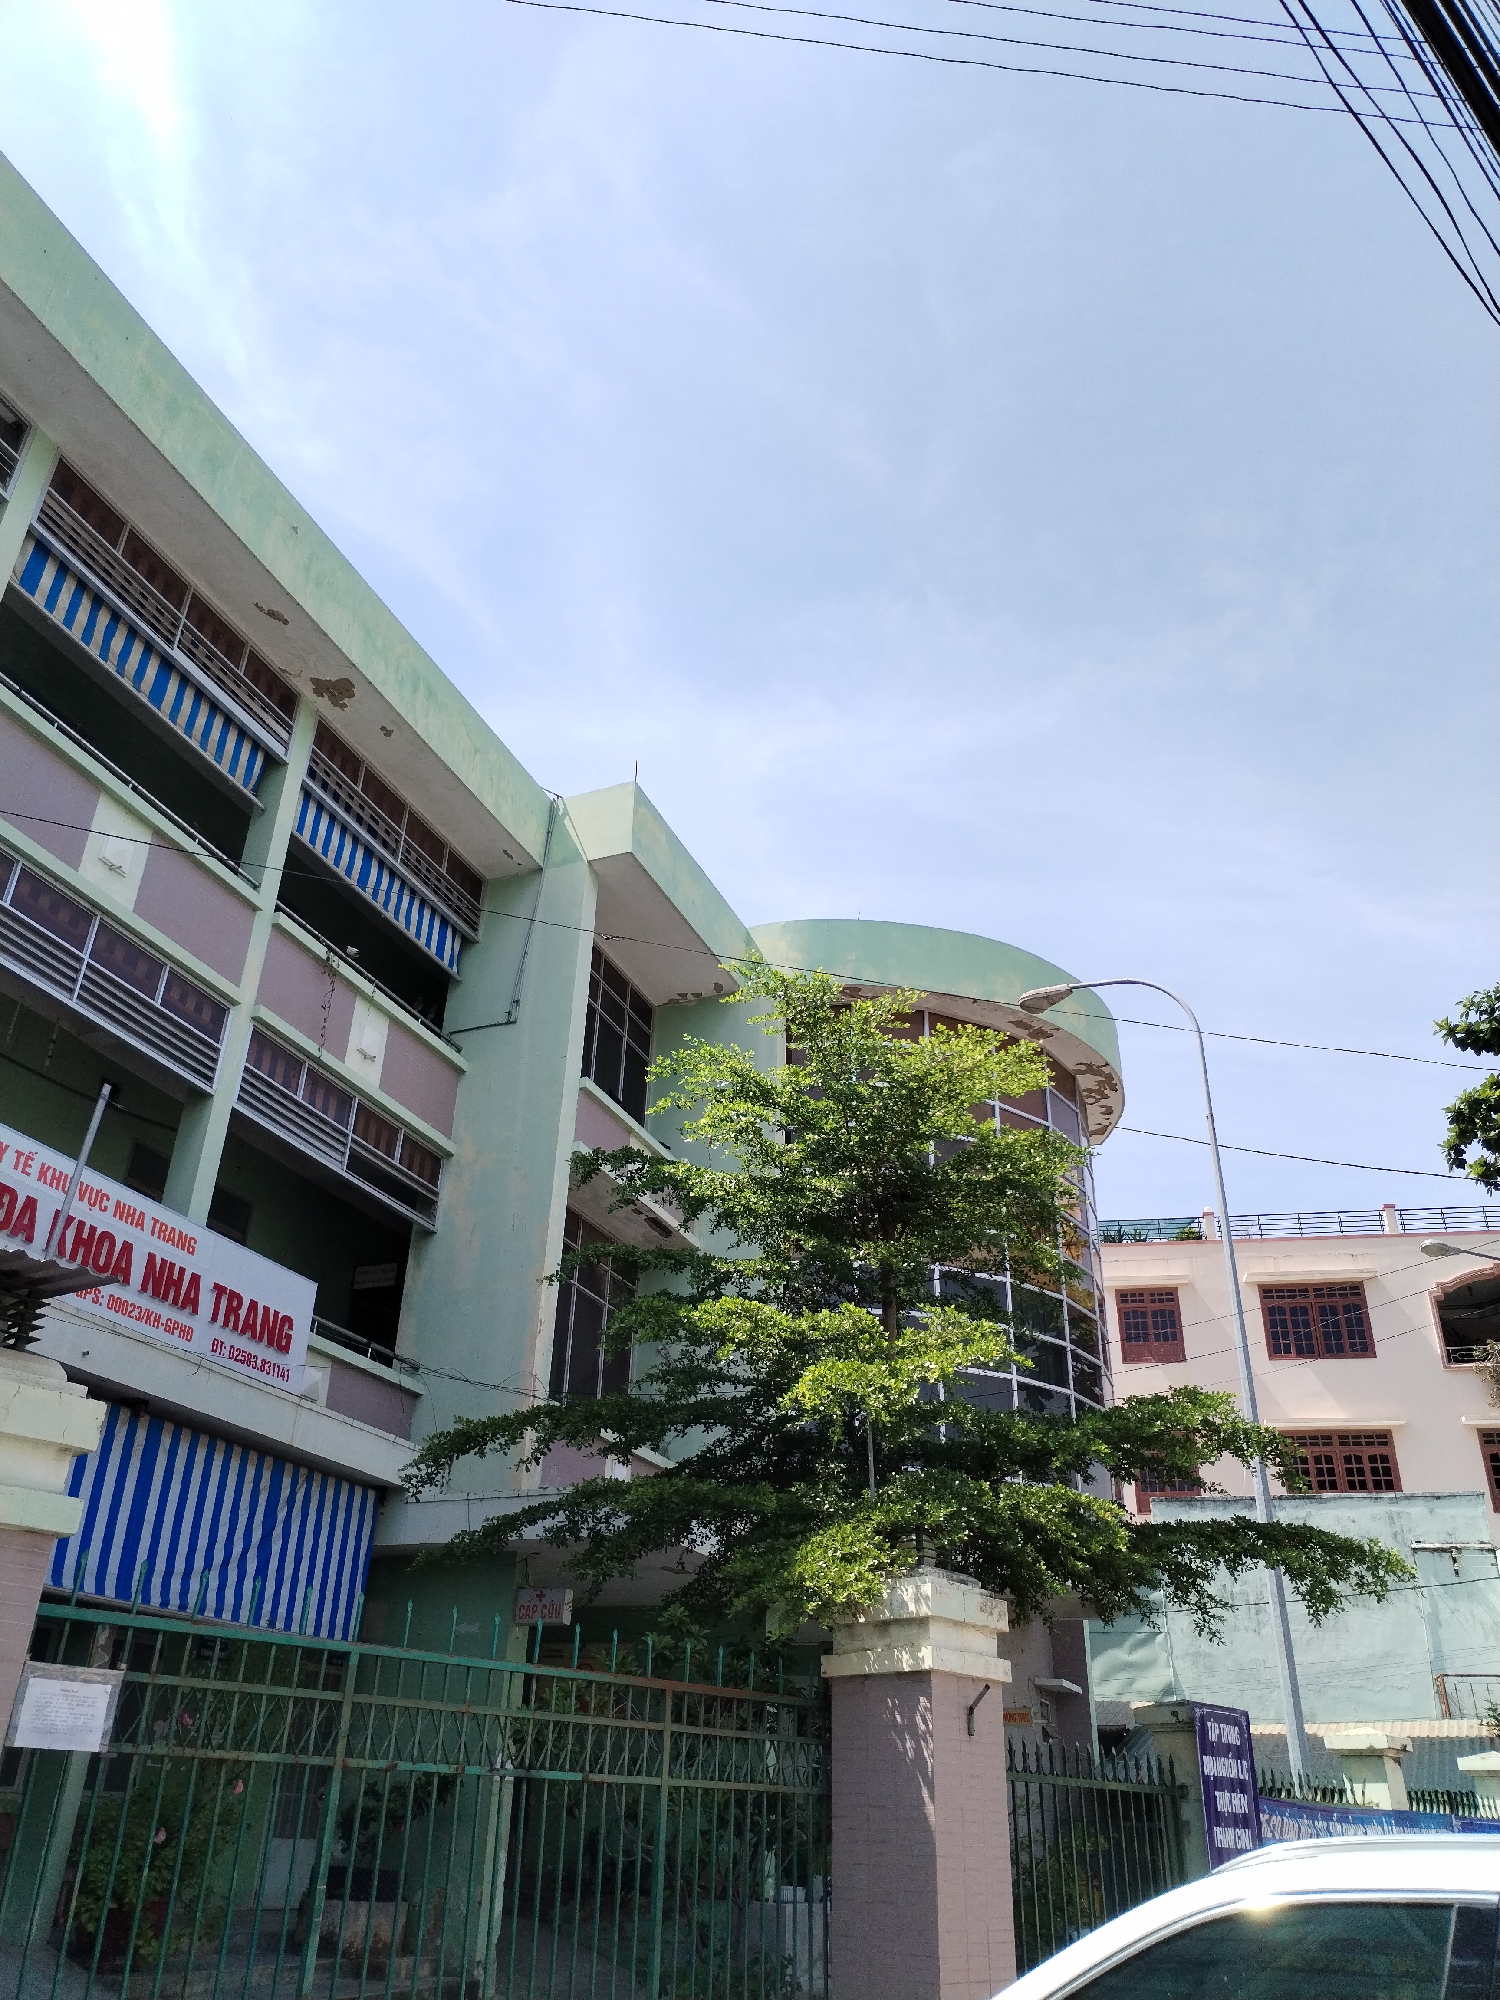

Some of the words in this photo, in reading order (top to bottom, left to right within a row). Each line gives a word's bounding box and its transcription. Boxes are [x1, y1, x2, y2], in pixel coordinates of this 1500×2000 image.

[13, 1149, 39, 1178] TẾ
[37, 1162, 74, 1195] KHU
[78, 1180, 111, 1212] VỰC
[113, 1199, 146, 1233] NHA
[150, 1216, 198, 1256] TRANG
[0, 1181, 38, 1244] ĐA
[45, 1208, 134, 1286] KHOA
[140, 1252, 201, 1315] NHA
[210, 1281, 294, 1354] TRANG
[211, 1337, 227, 1356] ĐT:
[518, 1599, 538, 1620] CẤP
[541, 1599, 562, 1620] CỨU
